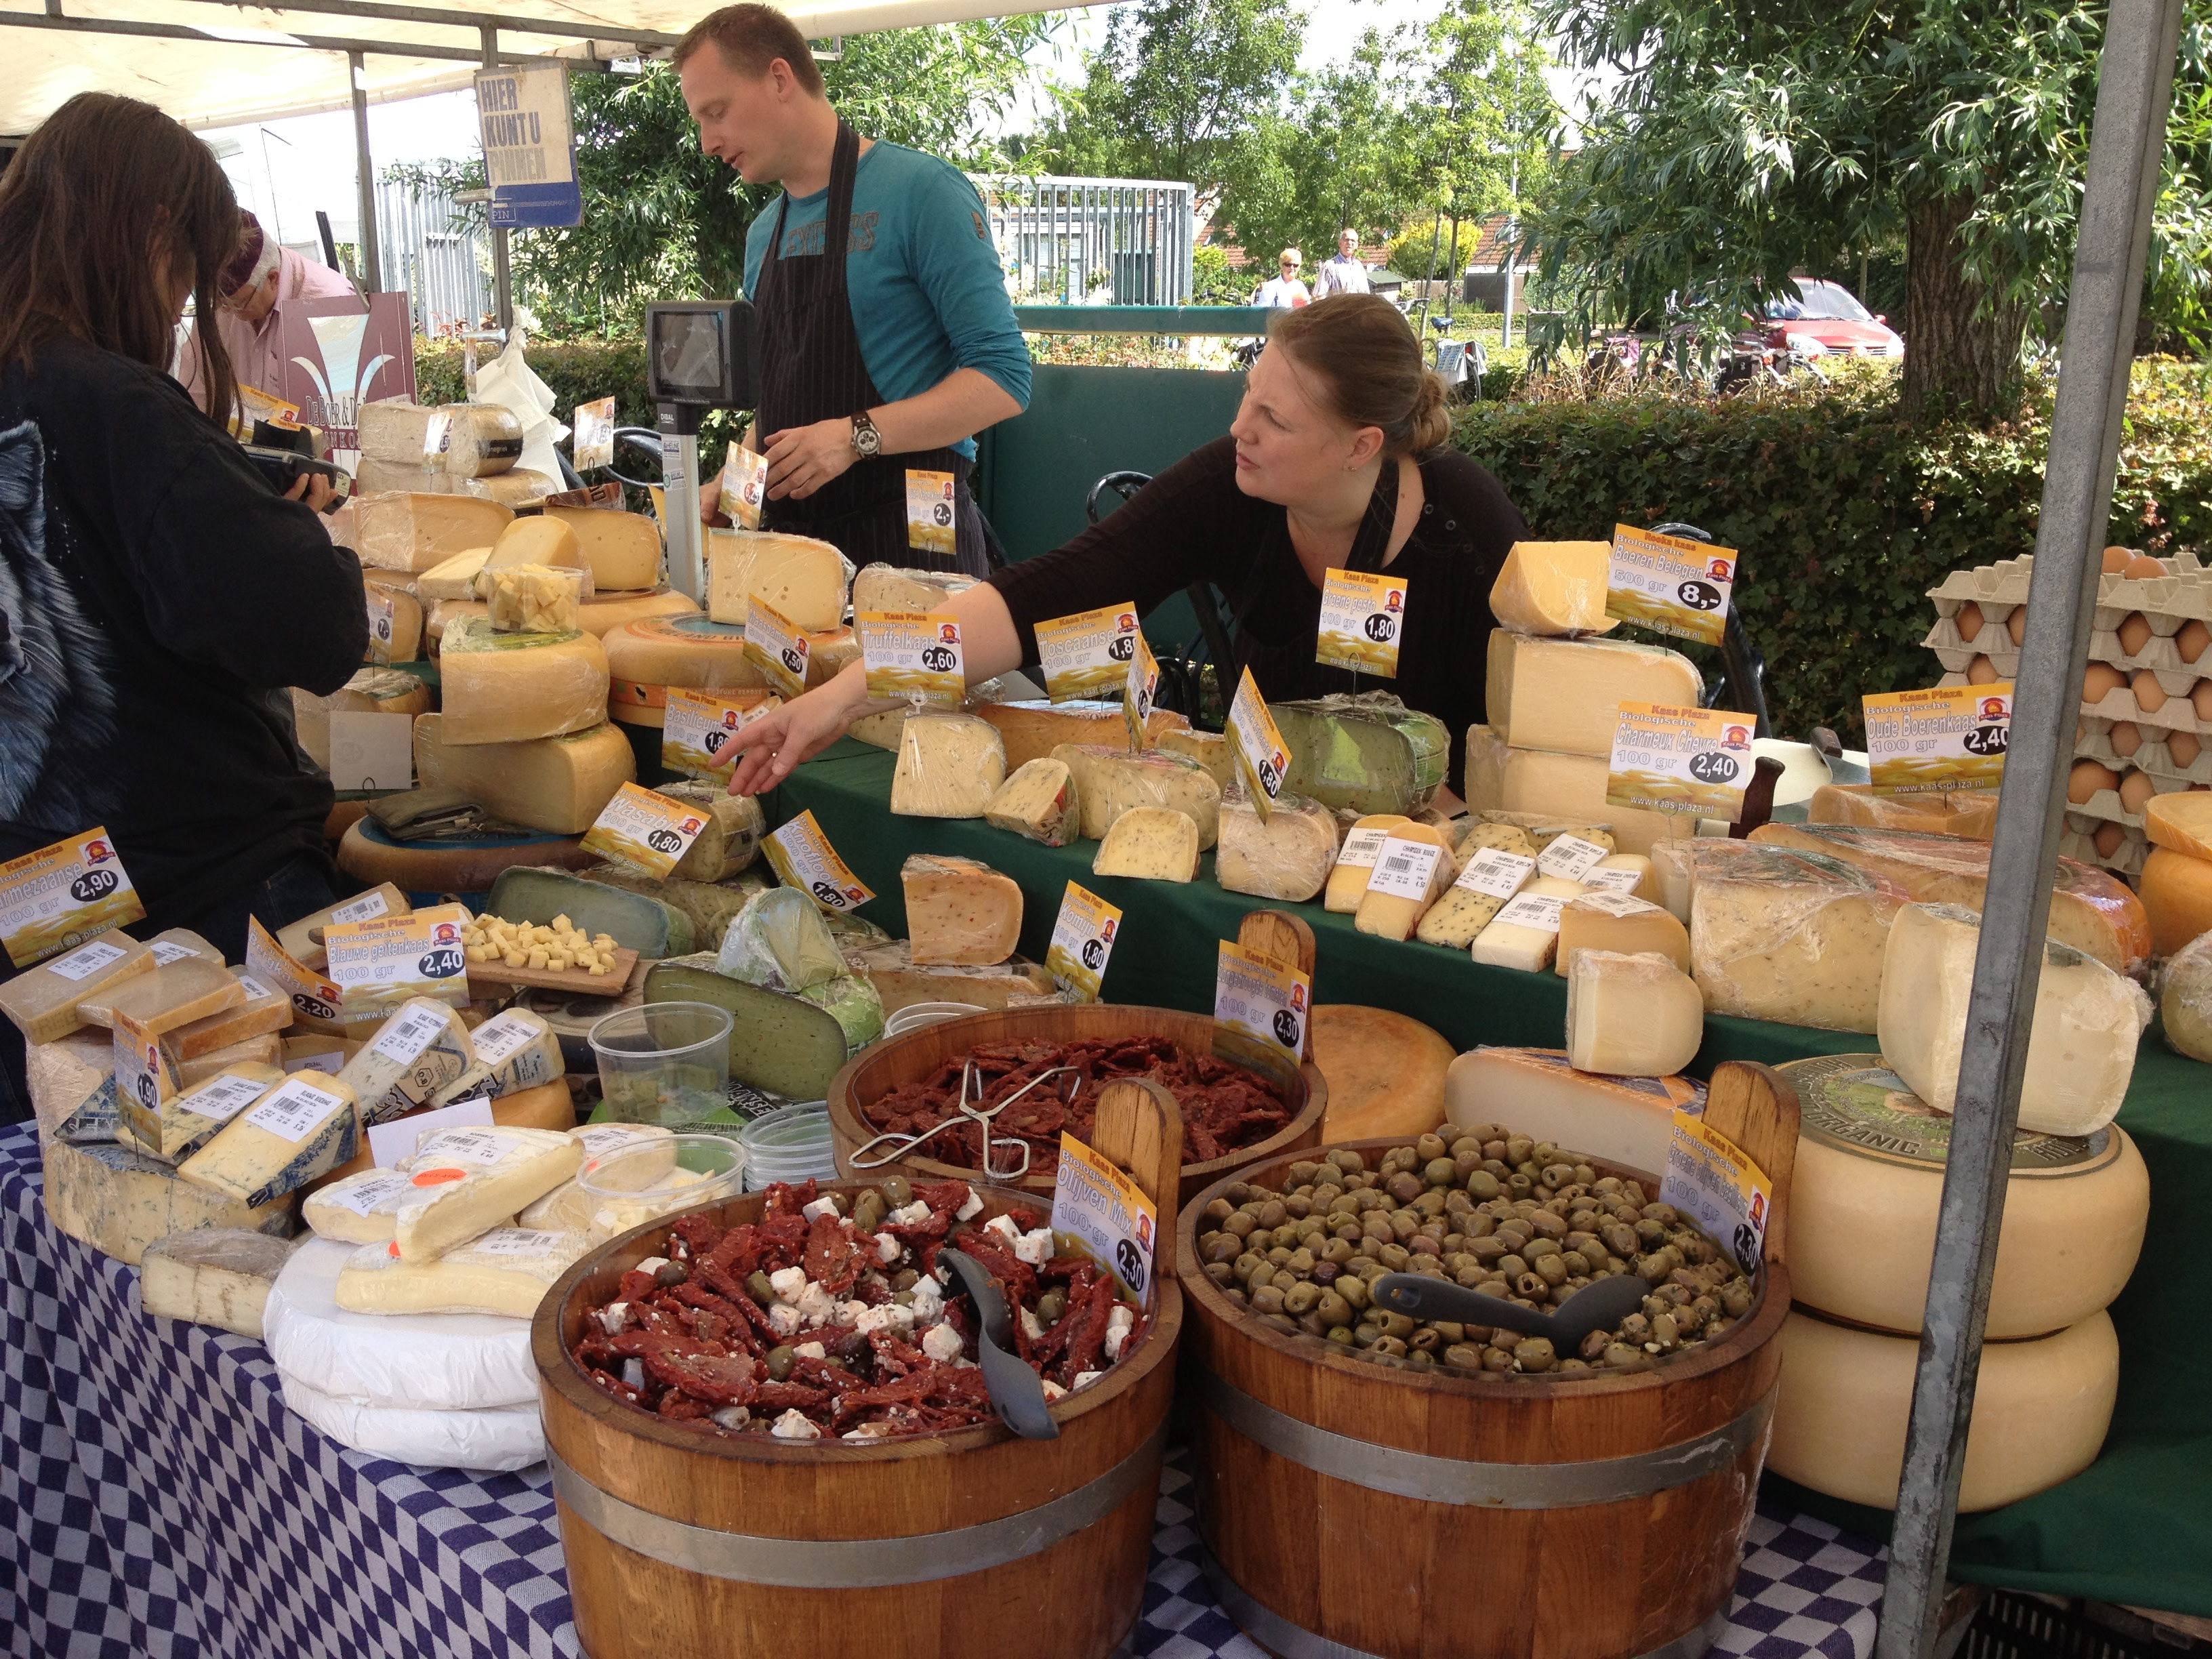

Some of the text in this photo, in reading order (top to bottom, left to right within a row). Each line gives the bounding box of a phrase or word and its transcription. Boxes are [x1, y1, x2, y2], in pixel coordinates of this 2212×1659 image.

[480, 78, 518, 112] HIER
[485, 112, 541, 147] KUNT U
[487, 147, 547, 181] PINNEN
[492, 211, 509, 220] PIN
[342, 397, 348, 426] &
[937, 506, 949, 523] 2,-
[1616, 535, 1683, 557] Biologische
[1614, 545, 1703, 580] Boeren Belegen
[1326, 579, 1371, 592] Biologische
[1344, 571, 1379, 584] Kaas Plaza
[1615, 569, 1666, 592] 500 gr
[1323, 588, 1376, 614] Groene pesto
[1682, 584, 1719, 609] 8,-
[861, 621, 919, 630] Biologische
[906, 613, 927, 621] Plaza
[1059, 611, 1103, 626] Kaas Plaza
[1322, 613, 1356, 630] 100 gr
[1368, 617, 1394, 639] 1,80
[861, 630, 937, 651] Truffelkaas
[1037, 621, 1096, 640] Biologische
[1038, 629, 1115, 659] Toscaanse
[785, 649, 801, 671] 7,50
[867, 651, 913, 664] 100 gr
[925, 651, 954, 670] 2,60
[1045, 652, 1091, 669] 100 gr
[667, 695, 710, 710] Biologische
[685, 692, 699, 701] Kaas
[701, 695, 717, 706] Plaza
[1866, 701, 1950, 715] Biologische
[1899, 690, 1963, 702] Kaas Plaza
[667, 703, 721, 734] Basilicum
[1619, 711, 1696, 727] Biologische
[1652, 705, 1710, 720] Kaas Plaza
[1867, 711, 1977, 739] Oude Boerenkaas
[666, 724, 698, 743] 100 gr
[1616, 722, 1718, 755] Charmeux Chevre
[1872, 739, 1938, 753] 100 gr
[1618, 750, 1677, 770] 100 gr
[1696, 755, 1734, 778] 2,40
[1261, 761, 1277, 796] 1,80
[619, 788, 669, 813] Biologische
[644, 790, 682, 810] Kaas Plaza
[1631, 796, 1714, 815] www.kaas-plaza.nl
[604, 813, 642, 834] 100 gr
[606, 795, 678, 832] Wasabi
[650, 832, 680, 853] 1,80
[782, 830, 811, 874] 100 gr
[800, 815, 837, 871] Biologische
[5, 845, 64, 872] Kaas Plaza
[787, 821, 841, 890] Knoflook
[818, 835, 848, 876] Kaas Plaza
[0, 858, 55, 884] logische
[75, 871, 114, 897] 2,90
[815, 884, 844, 906] 1,80
[0, 897, 59, 926] 100 gr
[1065, 891, 1095, 915] Biologische
[1080, 889, 1103, 909] Kaas Plaza
[359, 918, 416, 931] Kaas Plaza
[1059, 902, 1097, 937] Komijn
[327, 929, 406, 945] Biologische
[1055, 924, 1078, 949] 100 gr
[248, 931, 310, 995] Bergkaas
[329, 937, 430, 964] Blauwe geitenkaas
[424, 951, 464, 975] 2,40
[1085, 942, 1103, 968] 1,80
[1244, 949, 1284, 972] Kaas Plaza
[334, 964, 395, 981] 100 gr
[1221, 952, 1277, 979] Biologische
[297, 996, 333, 1019] 2,20
[1221, 996, 1265, 1023] 100 gr
[1277, 1012, 1297, 1041] 2,30
[139, 1077, 157, 1106] 1,90
[1803, 1111, 1922, 1155] ORGANIC
[1673, 1126, 1738, 1178] Biologische
[1704, 1128, 1748, 1171] Kaas Plaza
[1062, 1149, 1122, 1200] Biologische
[1089, 1151, 1130, 1193] Kaas Plaza
[1668, 1140, 1697, 1176] Groene
[1696, 1158, 1721, 1193] olijven
[1057, 1162, 1133, 1238] Olijven Mix
[1666, 1176, 1720, 1220] 100 gr
[1059, 1202, 1109, 1246] 100 gr
[1736, 1224, 1757, 1270] 2,30
[1119, 1244, 1143, 1290] 2,30
